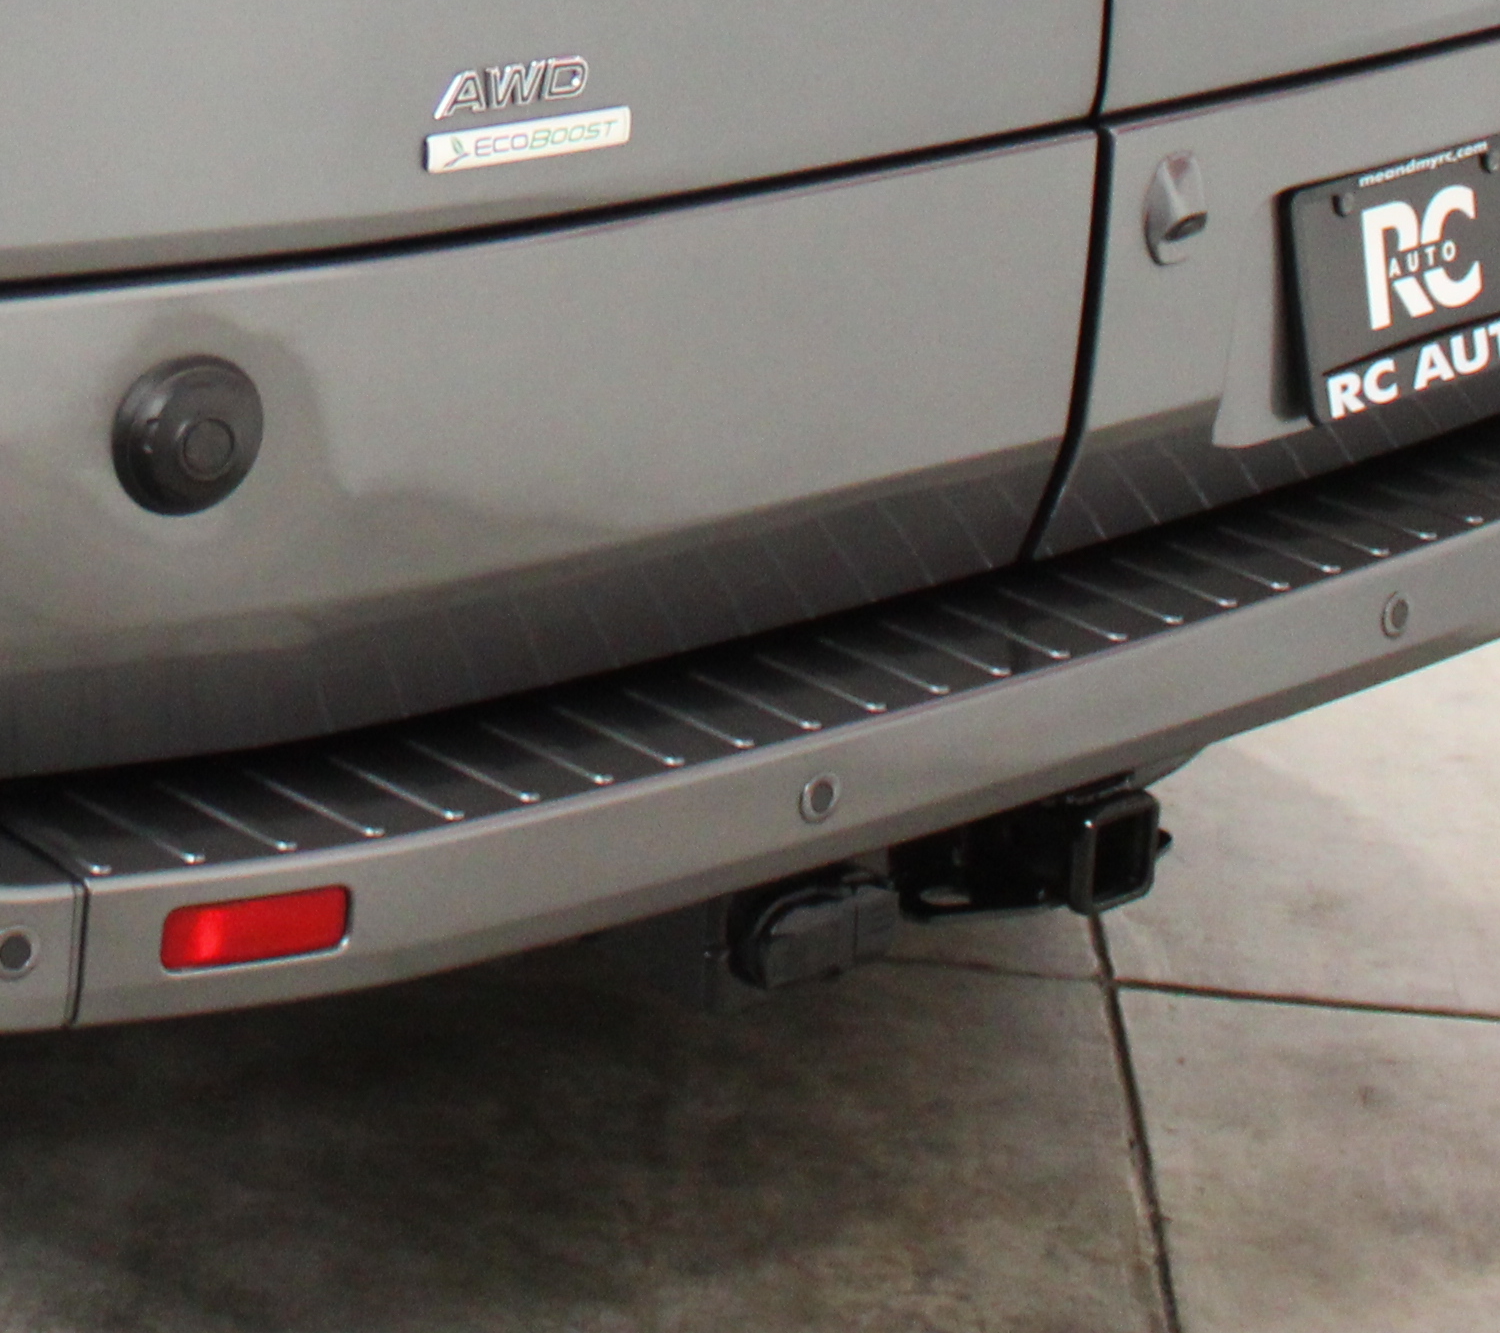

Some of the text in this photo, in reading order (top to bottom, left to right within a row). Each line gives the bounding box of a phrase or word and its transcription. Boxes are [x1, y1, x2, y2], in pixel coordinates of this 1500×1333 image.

[434, 55, 589, 120] AWD
[1358, 140, 1489, 188] meandmyrc.com
[1388, 239, 1457, 278] AUTO
[1326, 358, 1399, 420] RC
